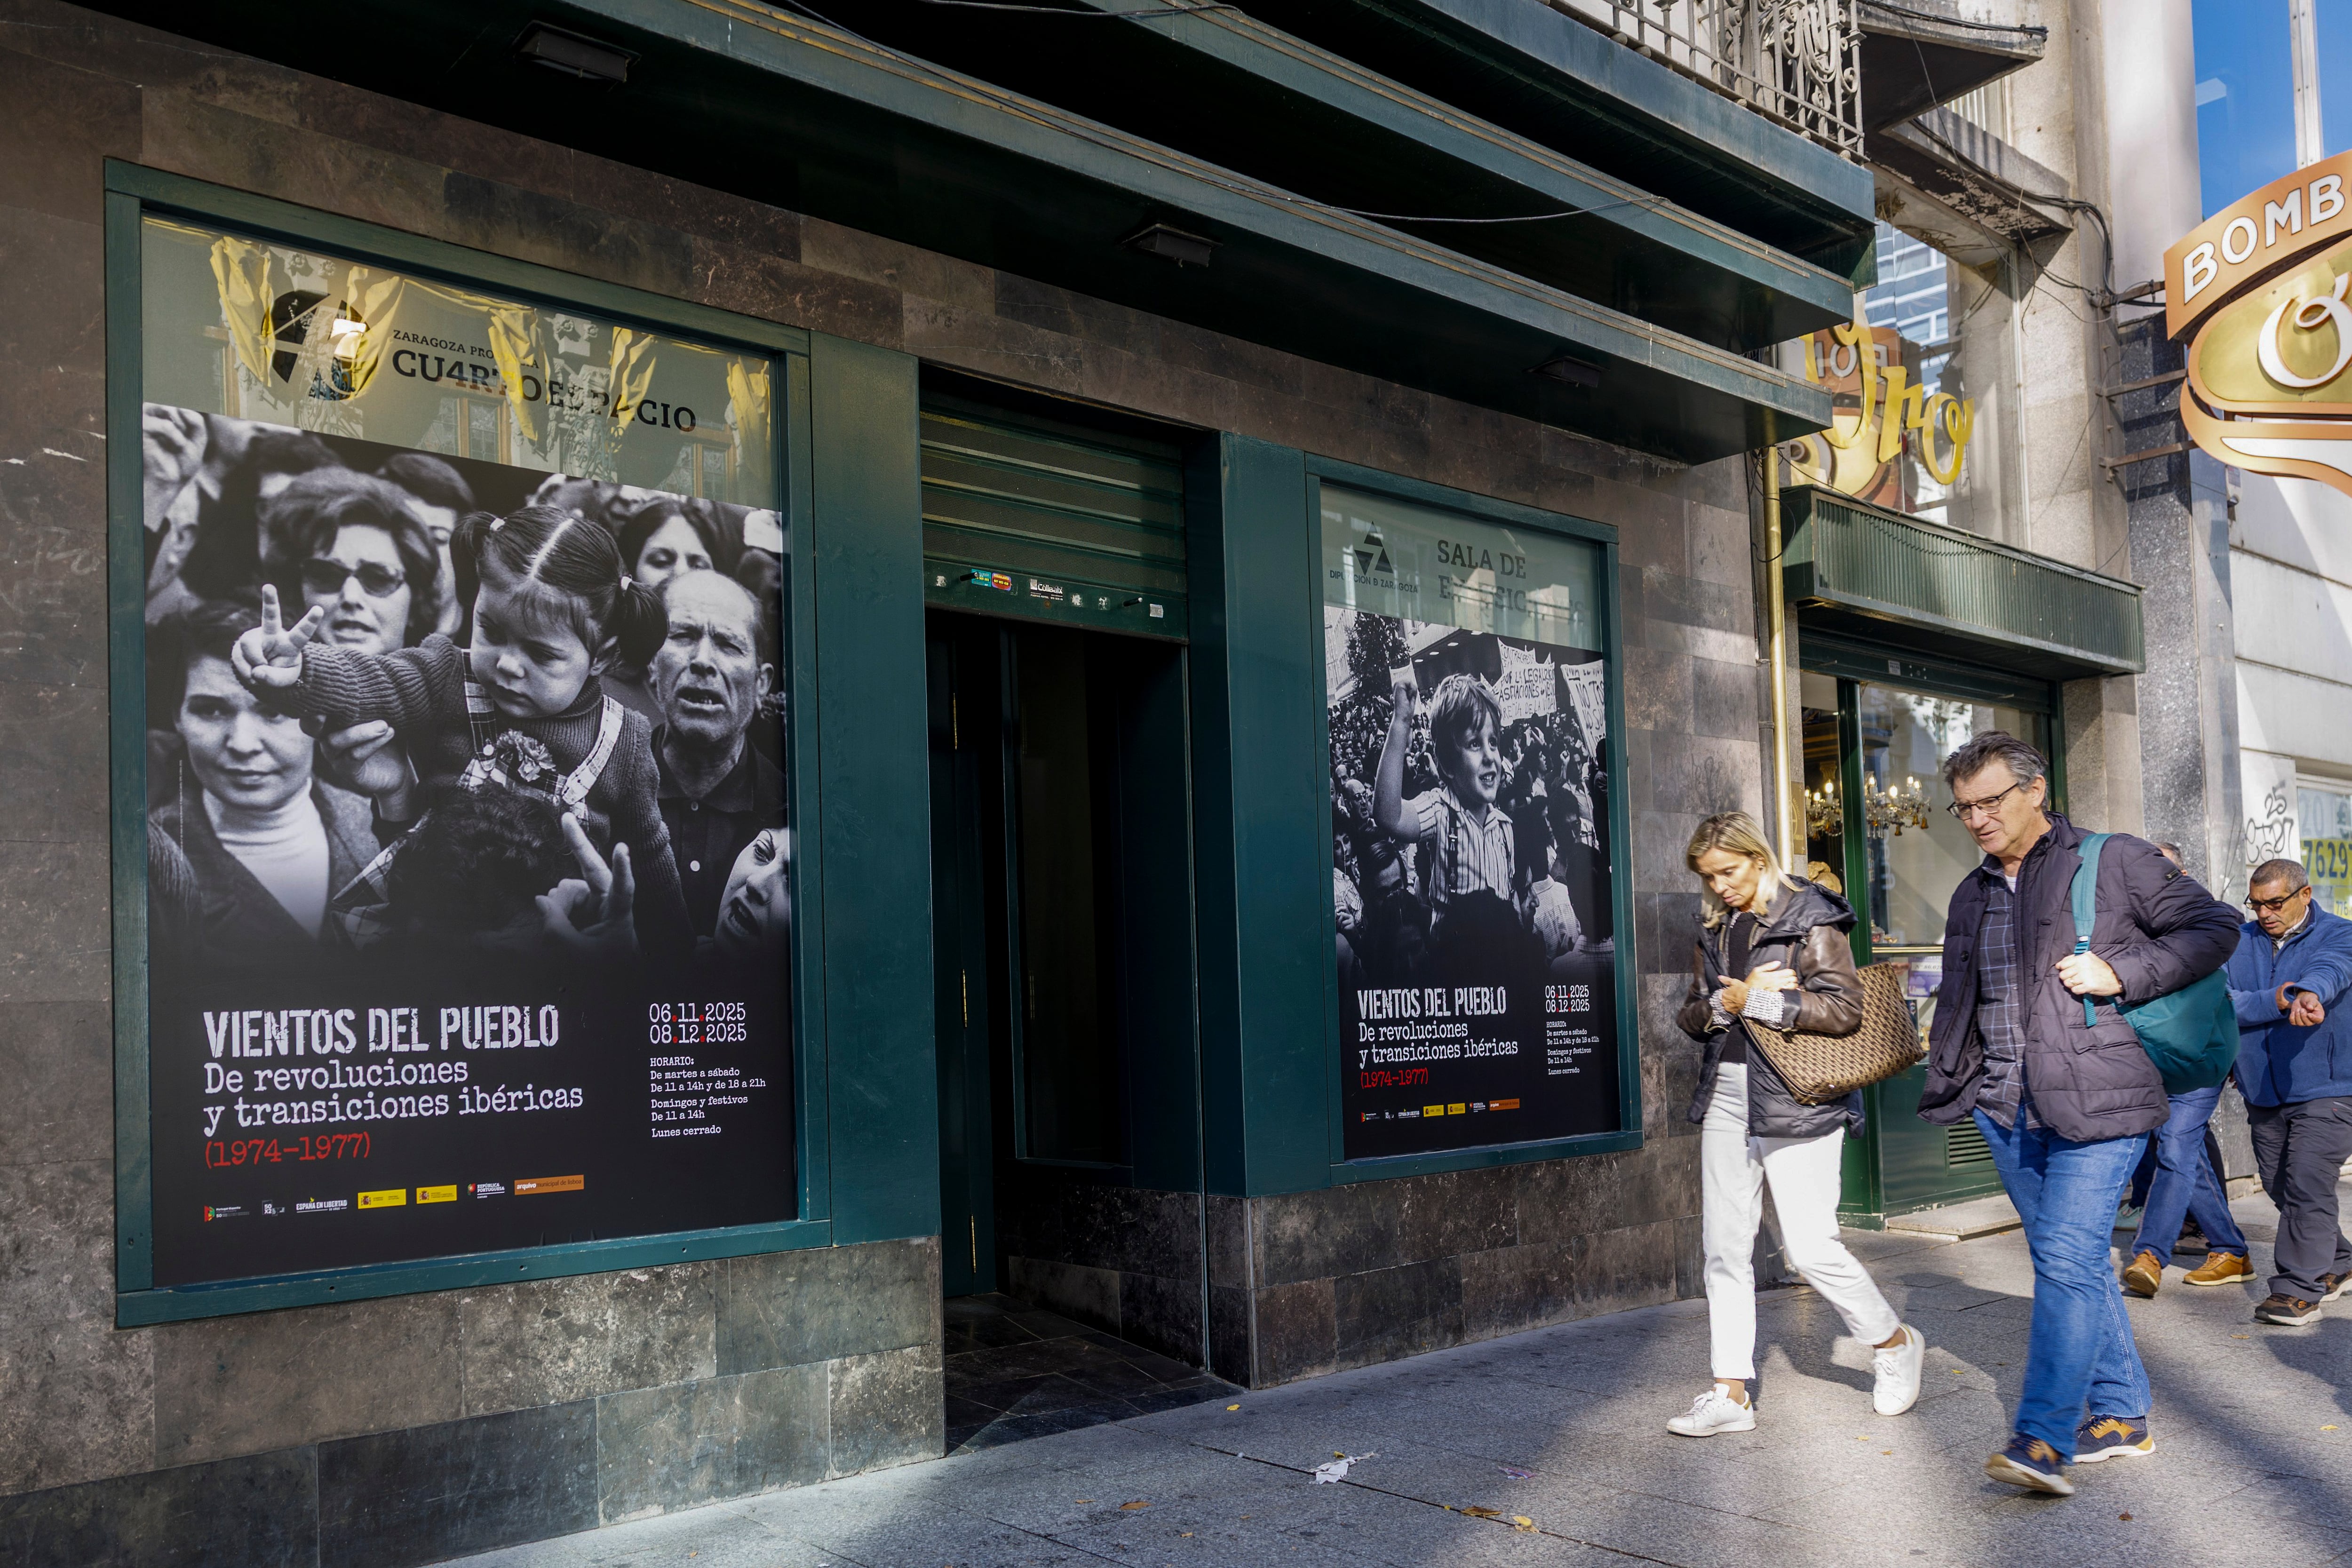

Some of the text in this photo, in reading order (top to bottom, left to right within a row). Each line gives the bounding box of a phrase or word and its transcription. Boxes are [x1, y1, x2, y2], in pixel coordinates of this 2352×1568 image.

[2183, 173, 2352, 305] BOMB
[393, 329, 466, 354] ZARAGOZA
[1438, 540, 1526, 579] SALA DE
[2303, 840, 2352, 879] 7629
[1545, 985, 1589, 999] 06.11.2025
[649, 1002, 746, 1023] 06.11.2025
[1357, 986, 1506, 1020] VIENTOS DEL PUEBLO
[1545, 999, 1590, 1013] 08.12.2025
[203, 1004, 558, 1059] VIENTOS DEL PUEBLO
[650, 1023, 747, 1044] 08.12.2025
[1359, 1020, 1468, 1042] De revoluciones
[650, 1056, 694, 1067] HORARIO:
[1359, 1038, 1518, 1069] y transiciones ibéricas
[205, 1058, 469, 1094] De revoluciones
[650, 1070, 662, 1080] De
[665, 1070, 698, 1079] martes
[707, 1067, 740, 1077] sábado
[1360, 1067, 1429, 1089] (1974-1977)
[651, 1083, 663, 1093] De
[665, 1082, 676, 1092] 11
[687, 1081, 704, 1090] 14h
[706, 1082, 713, 1092] y
[715, 1080, 726, 1089] de
[728, 1079, 739, 1089] 18
[749, 1078, 766, 1088] 21h
[204, 1085, 584, 1137] y transiciones ibéricas
[651, 1095, 748, 1108] Domingos y festivos
[652, 1112, 663, 1122] De
[665, 1111, 677, 1121] 11
[687, 1109, 705, 1119] 14h
[652, 1125, 722, 1138] Lunes cerrado
[205, 1131, 371, 1169] (1974-1977)
[516, 1182, 537, 1190] arquivo
[324, 1200, 347, 1208] LIBERTAD
